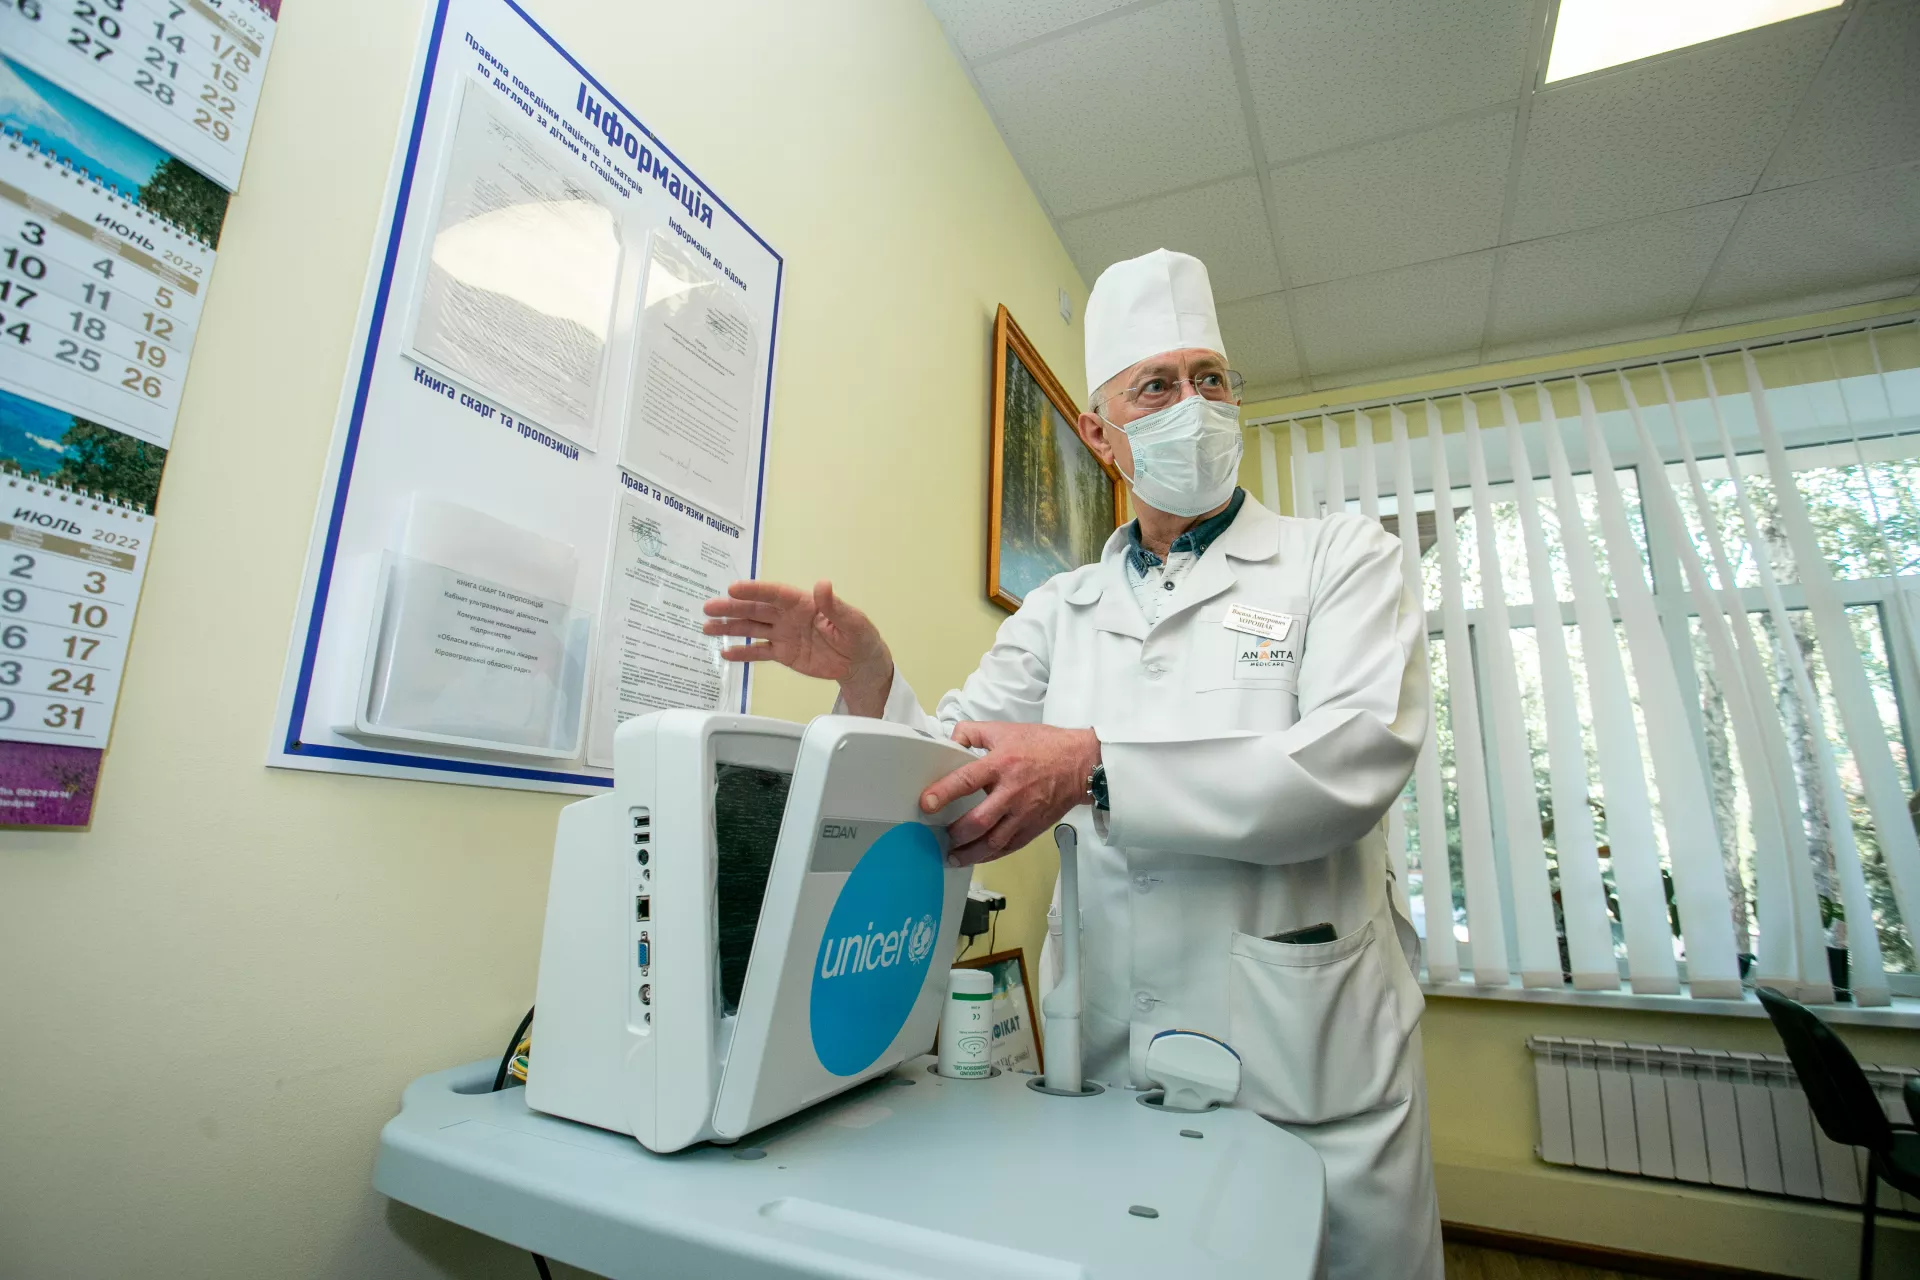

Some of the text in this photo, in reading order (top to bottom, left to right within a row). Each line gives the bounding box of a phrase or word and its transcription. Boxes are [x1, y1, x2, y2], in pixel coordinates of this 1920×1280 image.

[153, 21, 185, 54] 14
[211, 62, 239, 93] 15
[169, 0, 185, 20] 7
[211, 33, 251, 74] 1/8
[227, 10, 265, 42] 2022
[67, 27, 113, 61] 27
[134, 70, 175, 106] 28
[193, 108, 230, 143] 29
[73, 0, 236, 120] 20 21 22
[465, 31, 509, 77] Правила
[512, 75, 559, 122] поведінки
[562, 119, 600, 158] пацієнтів
[602, 153, 612, 168] та
[613, 163, 643, 195] матерів
[477, 61, 490, 79] по
[493, 76, 534, 118] догляду
[536, 113, 547, 128] за
[549, 123, 579, 157] дітьми
[582, 152, 587, 162] в
[590, 160, 631, 199] стаціонарі
[576, 81, 713, 229] Інформація
[20, 220, 174, 310] 3 4 5
[95, 212, 155, 251] ИЮНЬ
[163, 250, 203, 278] 2022
[669, 216, 747, 292] Інформація до відома
[0, 280, 166, 369] 17 18 19
[3, 247, 174, 342] 10 11 12
[55, 338, 102, 374] 25
[121, 367, 162, 400] 26
[414, 366, 579, 461] Книга скарг та пропозицій
[13, 507, 141, 551] ИЮЛЬ 2022
[620, 471, 649, 495] Права
[652, 488, 661, 501] та
[706, 518, 740, 539] пацієнтів
[9, 553, 107, 595] 2 3
[456, 578, 544, 609] КНИГА СКАРГ ТА ПРОПОЗИЦІЙ
[1, 588, 108, 629] 9 10
[62, 635, 101, 661] 17
[1241, 650, 1294, 660] ANANTA
[47, 668, 96, 697] 24
[43, 703, 86, 731] 31
[822, 825, 858, 840] EDAN
[821, 916, 912, 979] unicef
